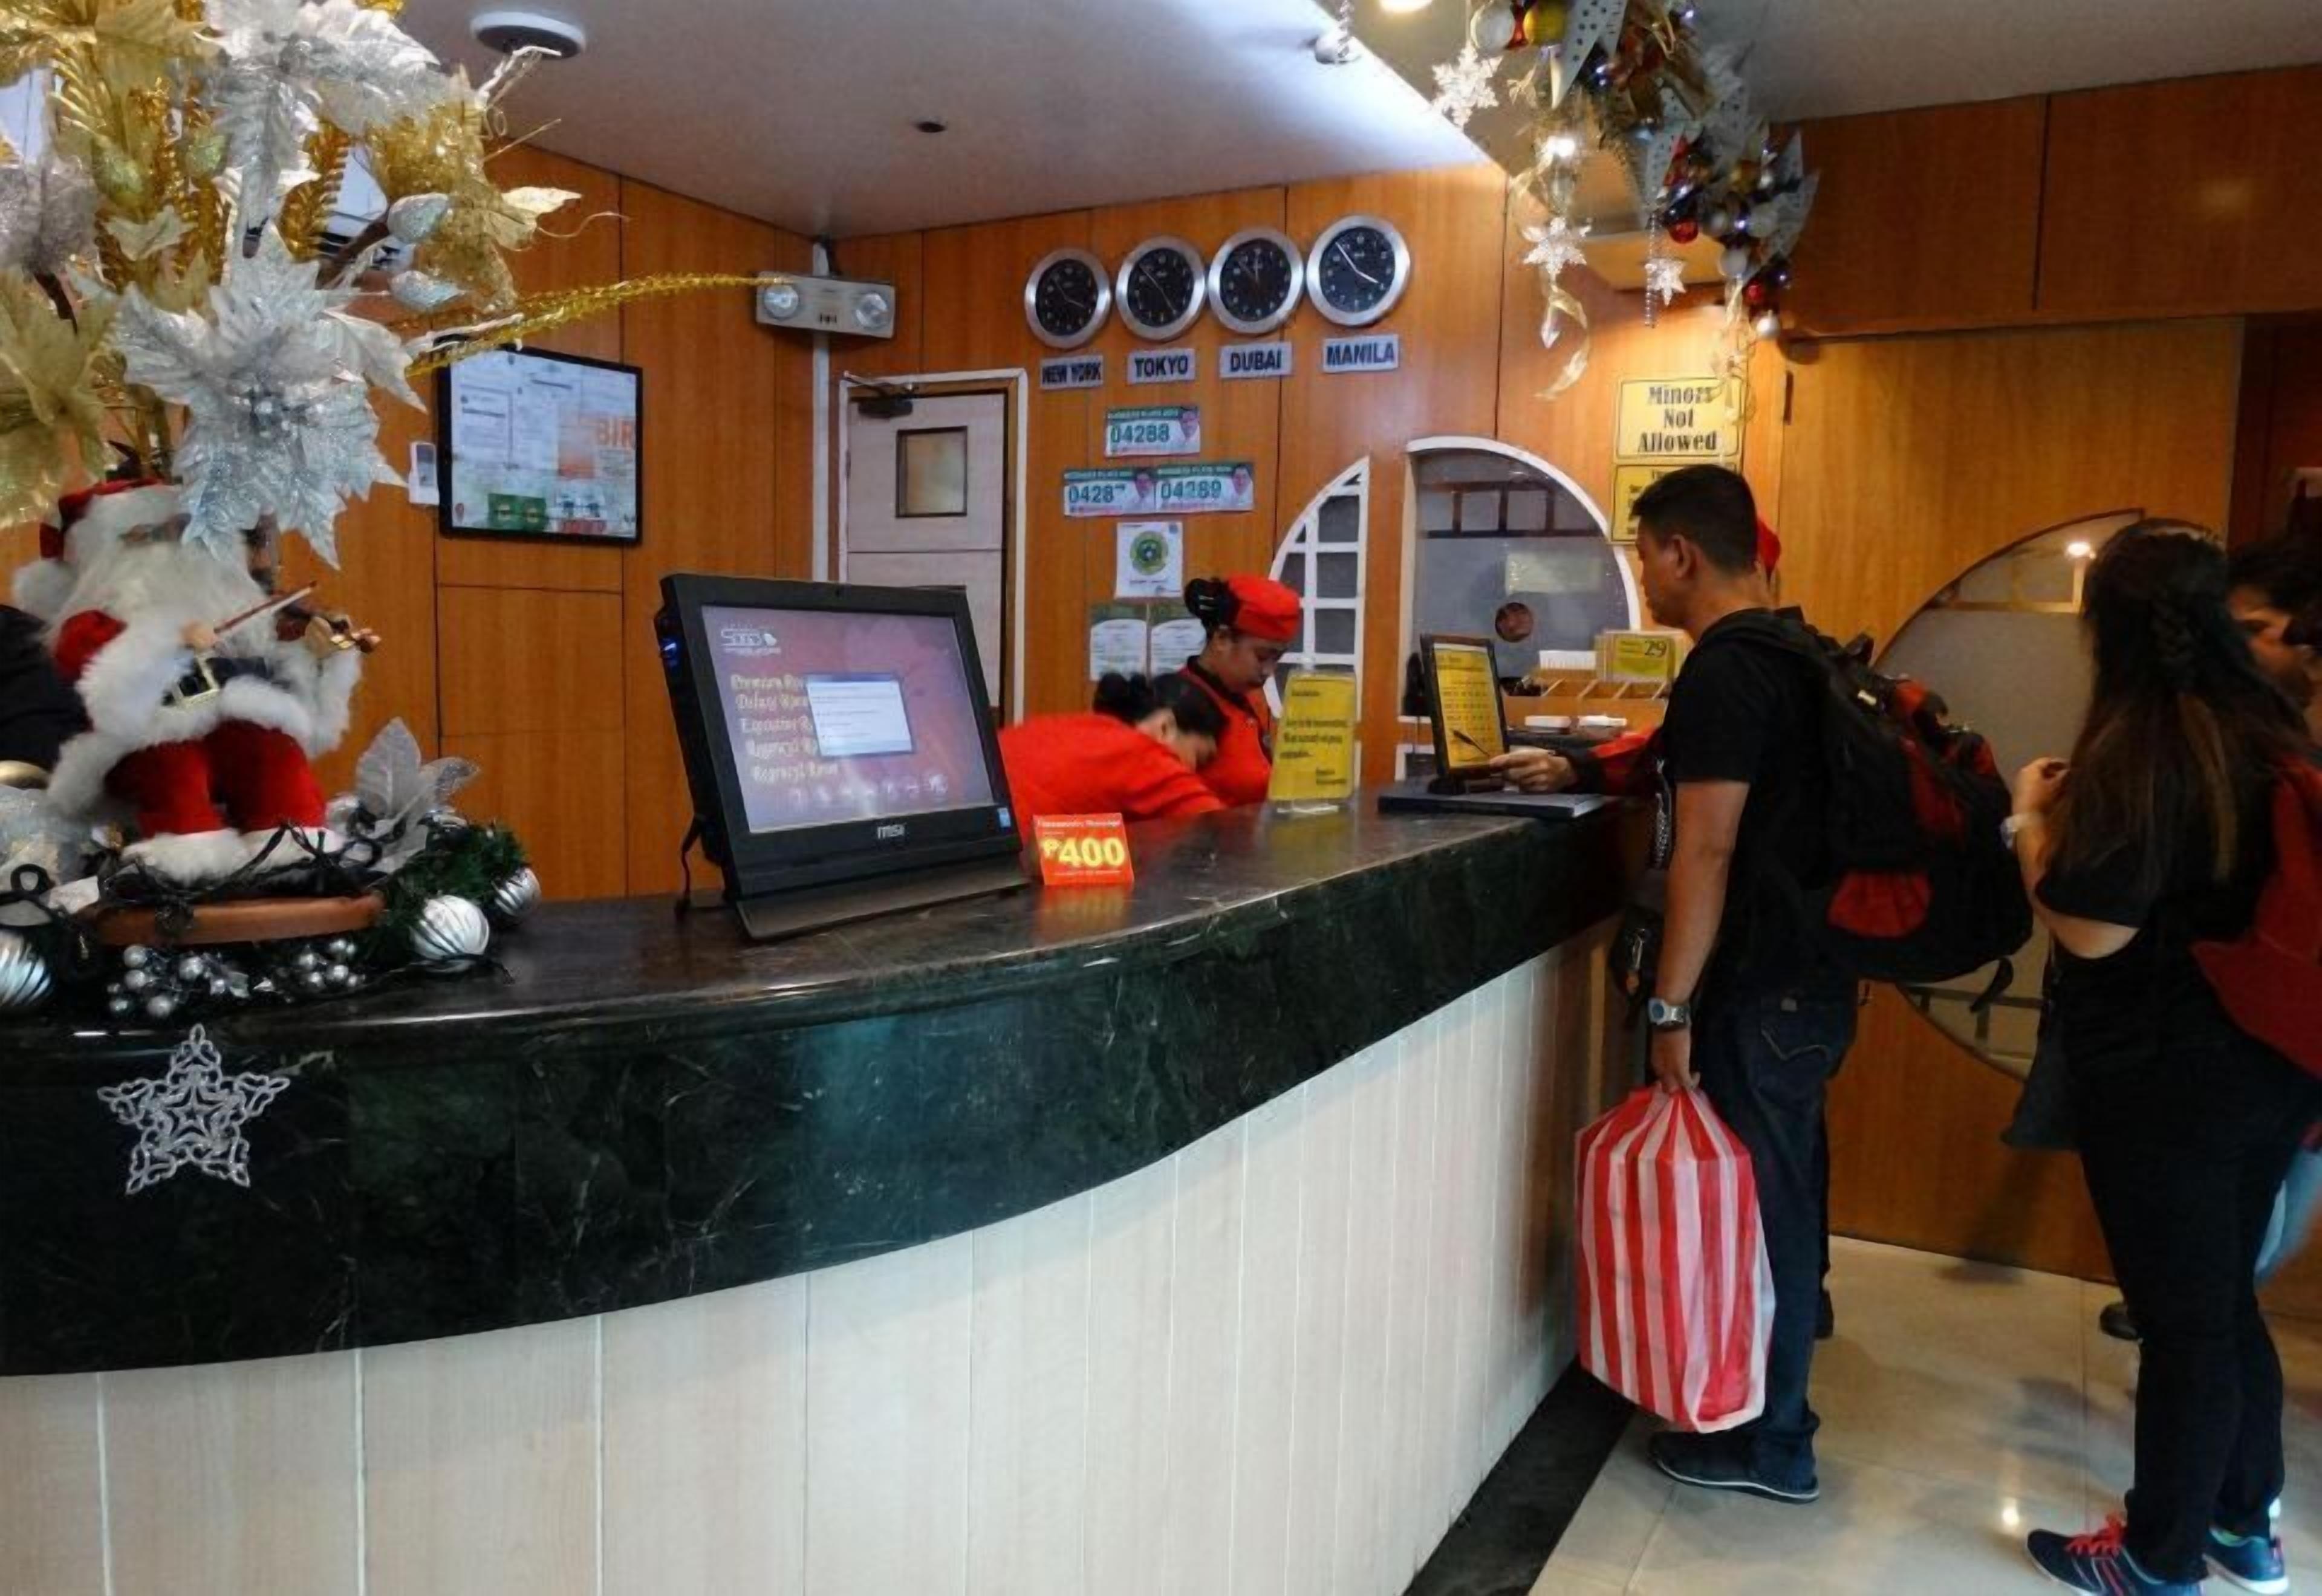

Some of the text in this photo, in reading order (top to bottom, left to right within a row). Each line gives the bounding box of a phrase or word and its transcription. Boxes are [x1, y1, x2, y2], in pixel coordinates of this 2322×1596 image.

[1230, 348, 1282, 372] DUBAI
[1327, 343, 1395, 365] MANILA
[1134, 355, 1188, 377] TOKYO
[1664, 408, 1694, 429] Not
[1110, 423, 1170, 443] 04288
[1637, 430, 1717, 452] Allowed
[1644, 640, 1667, 658] 29
